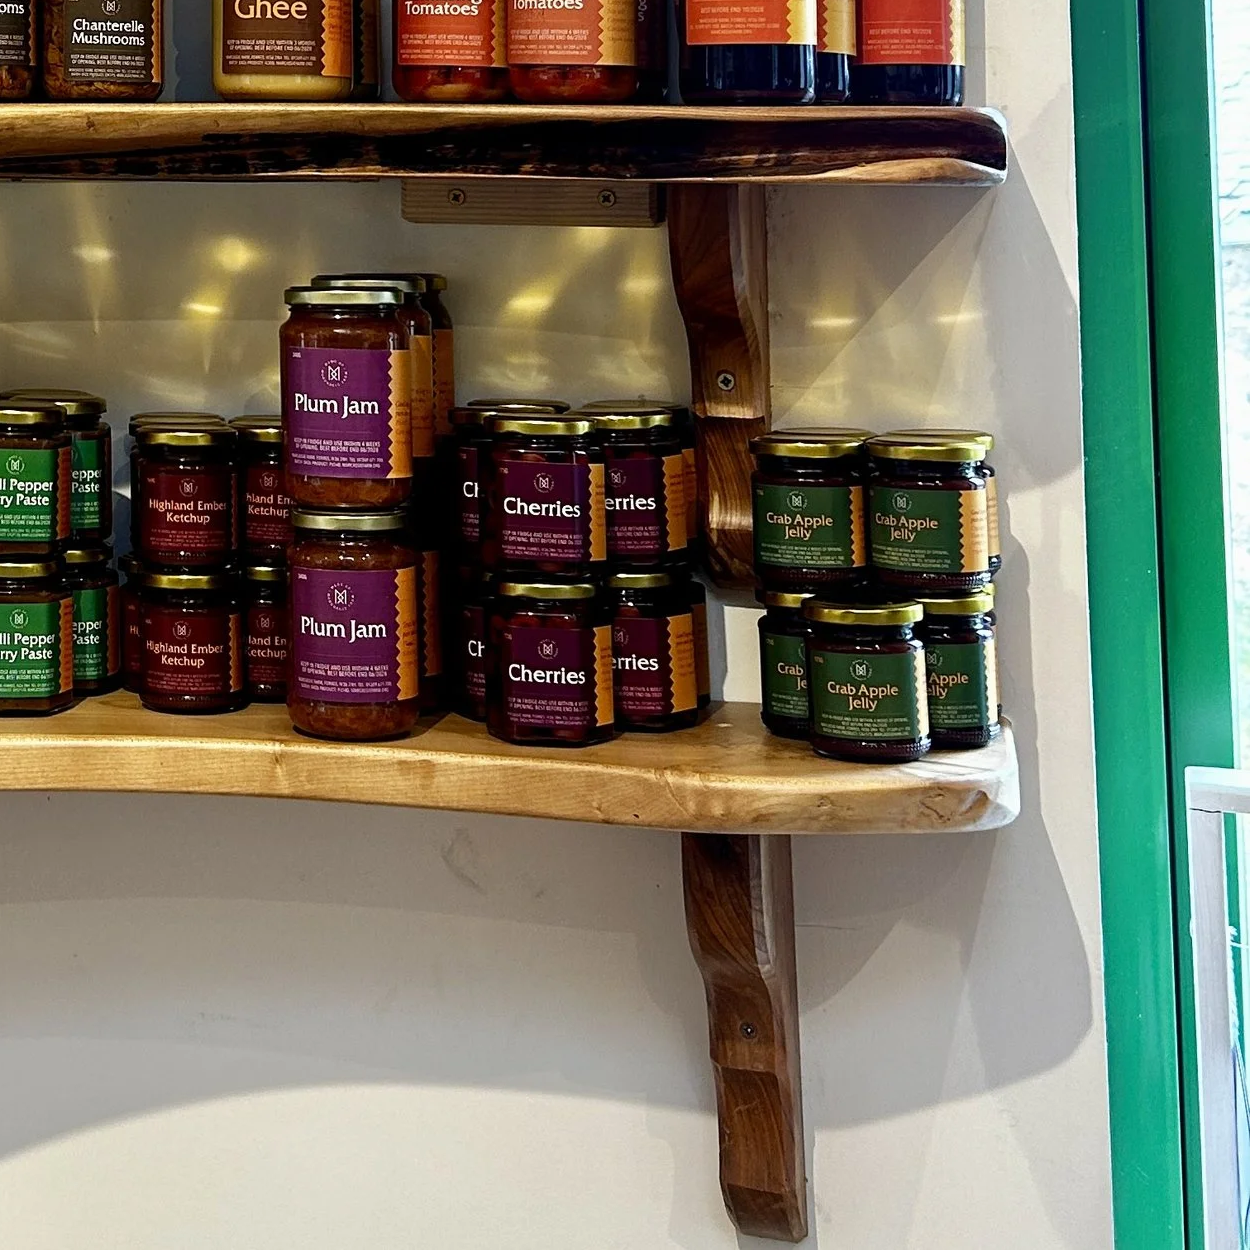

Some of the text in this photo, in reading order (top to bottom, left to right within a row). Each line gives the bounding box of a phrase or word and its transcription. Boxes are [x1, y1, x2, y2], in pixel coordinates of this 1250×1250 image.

[405, 0, 478, 16] Tomatoes
[73, 19, 144, 33] Chanterelle
[71, 32, 145, 46] Mushrooms
[295, 393, 379, 419] Plum Jam
[71, 469, 102, 482] epper
[9, 479, 54, 494] Pepper
[71, 482, 100, 493] Paste
[16, 493, 50, 507] Paste
[149, 497, 227, 512] Highland Ember
[246, 493, 274, 504] hland
[605, 494, 656, 511] erries
[503, 497, 581, 518] Cherries
[166, 512, 210, 525] Ketchup
[766, 512, 833, 529] Crab Apple
[875, 512, 939, 530] Crab Apple
[784, 526, 812, 541] Jelly
[890, 527, 916, 543] Jelly
[71, 620, 102, 635] epper
[301, 615, 387, 644] Plum Jam
[14, 633, 55, 649] Pepper
[146, 640, 223, 654] Highland Ember
[20, 647, 53, 660] Paste
[161, 655, 205, 669] Ketchup
[611, 654, 659, 671] erries
[777, 662, 804, 676] Crab
[508, 663, 586, 685] Cherries
[928, 672, 969, 685] Apple
[827, 681, 899, 697] Crab Apple
[926, 684, 947, 699] elly
[848, 696, 878, 712] Jelly
